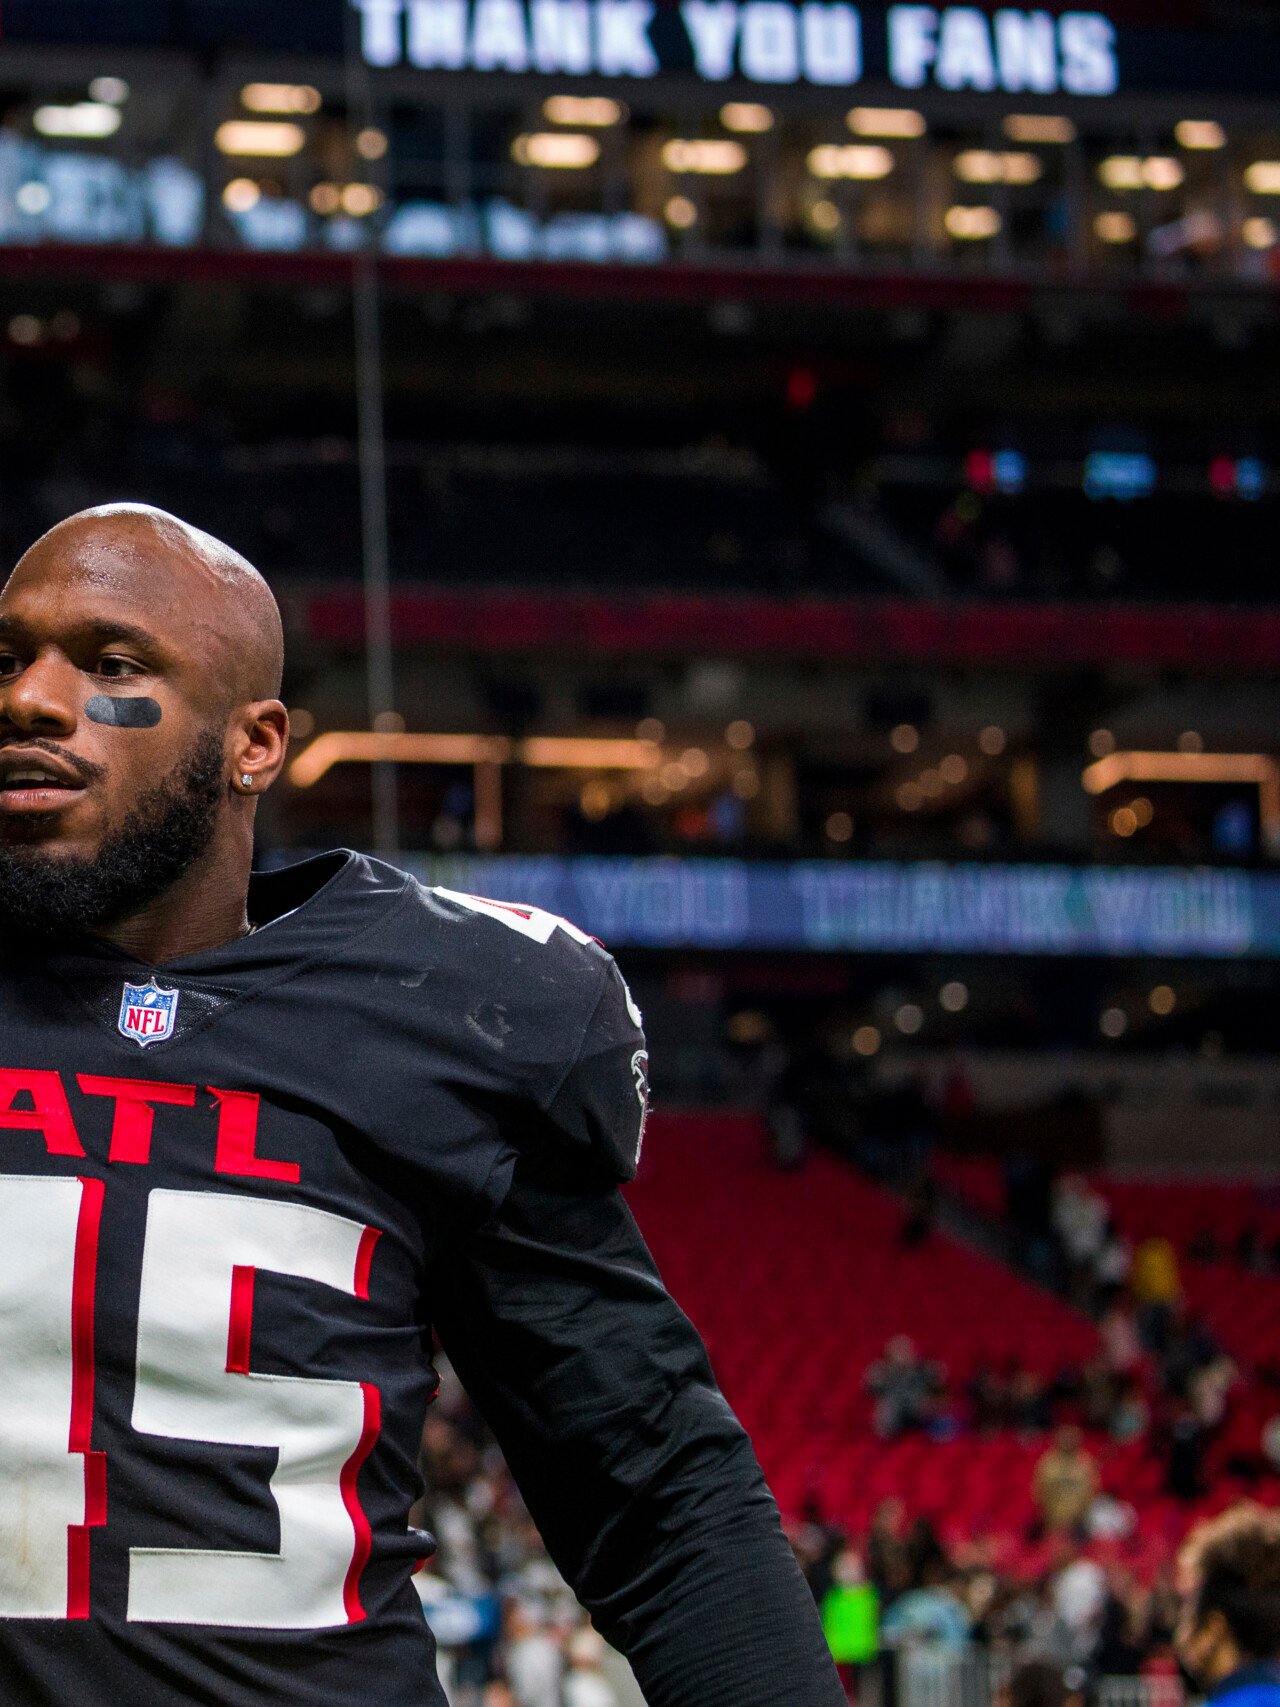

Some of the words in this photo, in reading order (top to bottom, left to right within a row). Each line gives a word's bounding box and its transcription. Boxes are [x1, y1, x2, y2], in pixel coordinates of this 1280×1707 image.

[352, 0, 660, 79] THANK
[678, 0, 863, 86] YOU
[887, 3, 1119, 95] FANS
[126, 1007, 166, 1035] NFL
